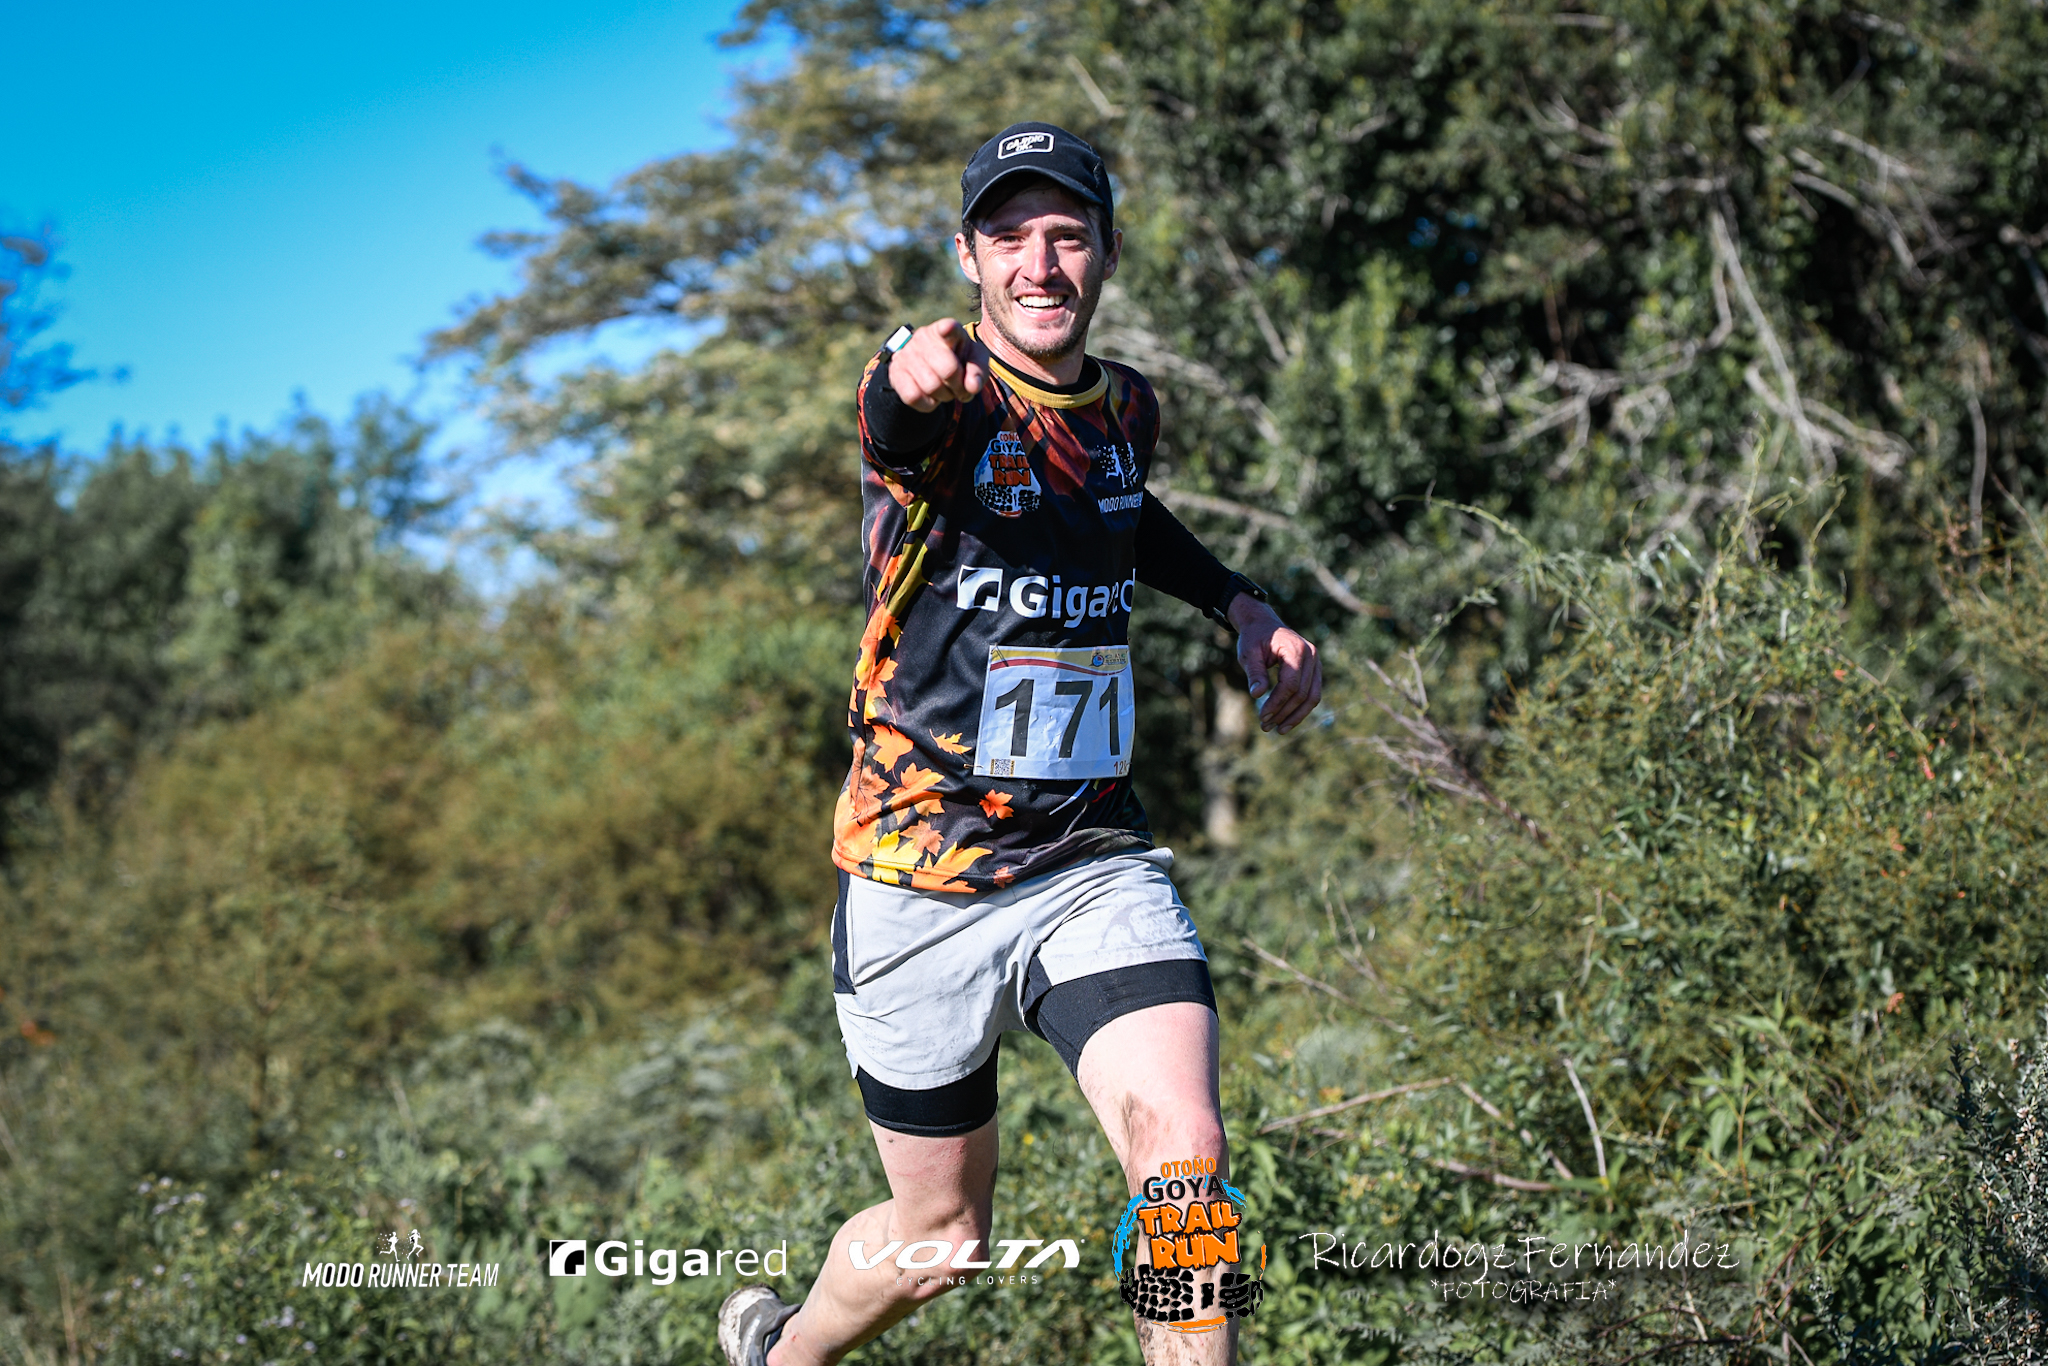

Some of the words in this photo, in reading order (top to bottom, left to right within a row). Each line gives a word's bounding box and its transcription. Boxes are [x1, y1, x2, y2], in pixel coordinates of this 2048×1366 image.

[1097, 496, 1120, 514] MODO
[1009, 567, 1136, 629] Gigaed
[995, 677, 1121, 759] 171
